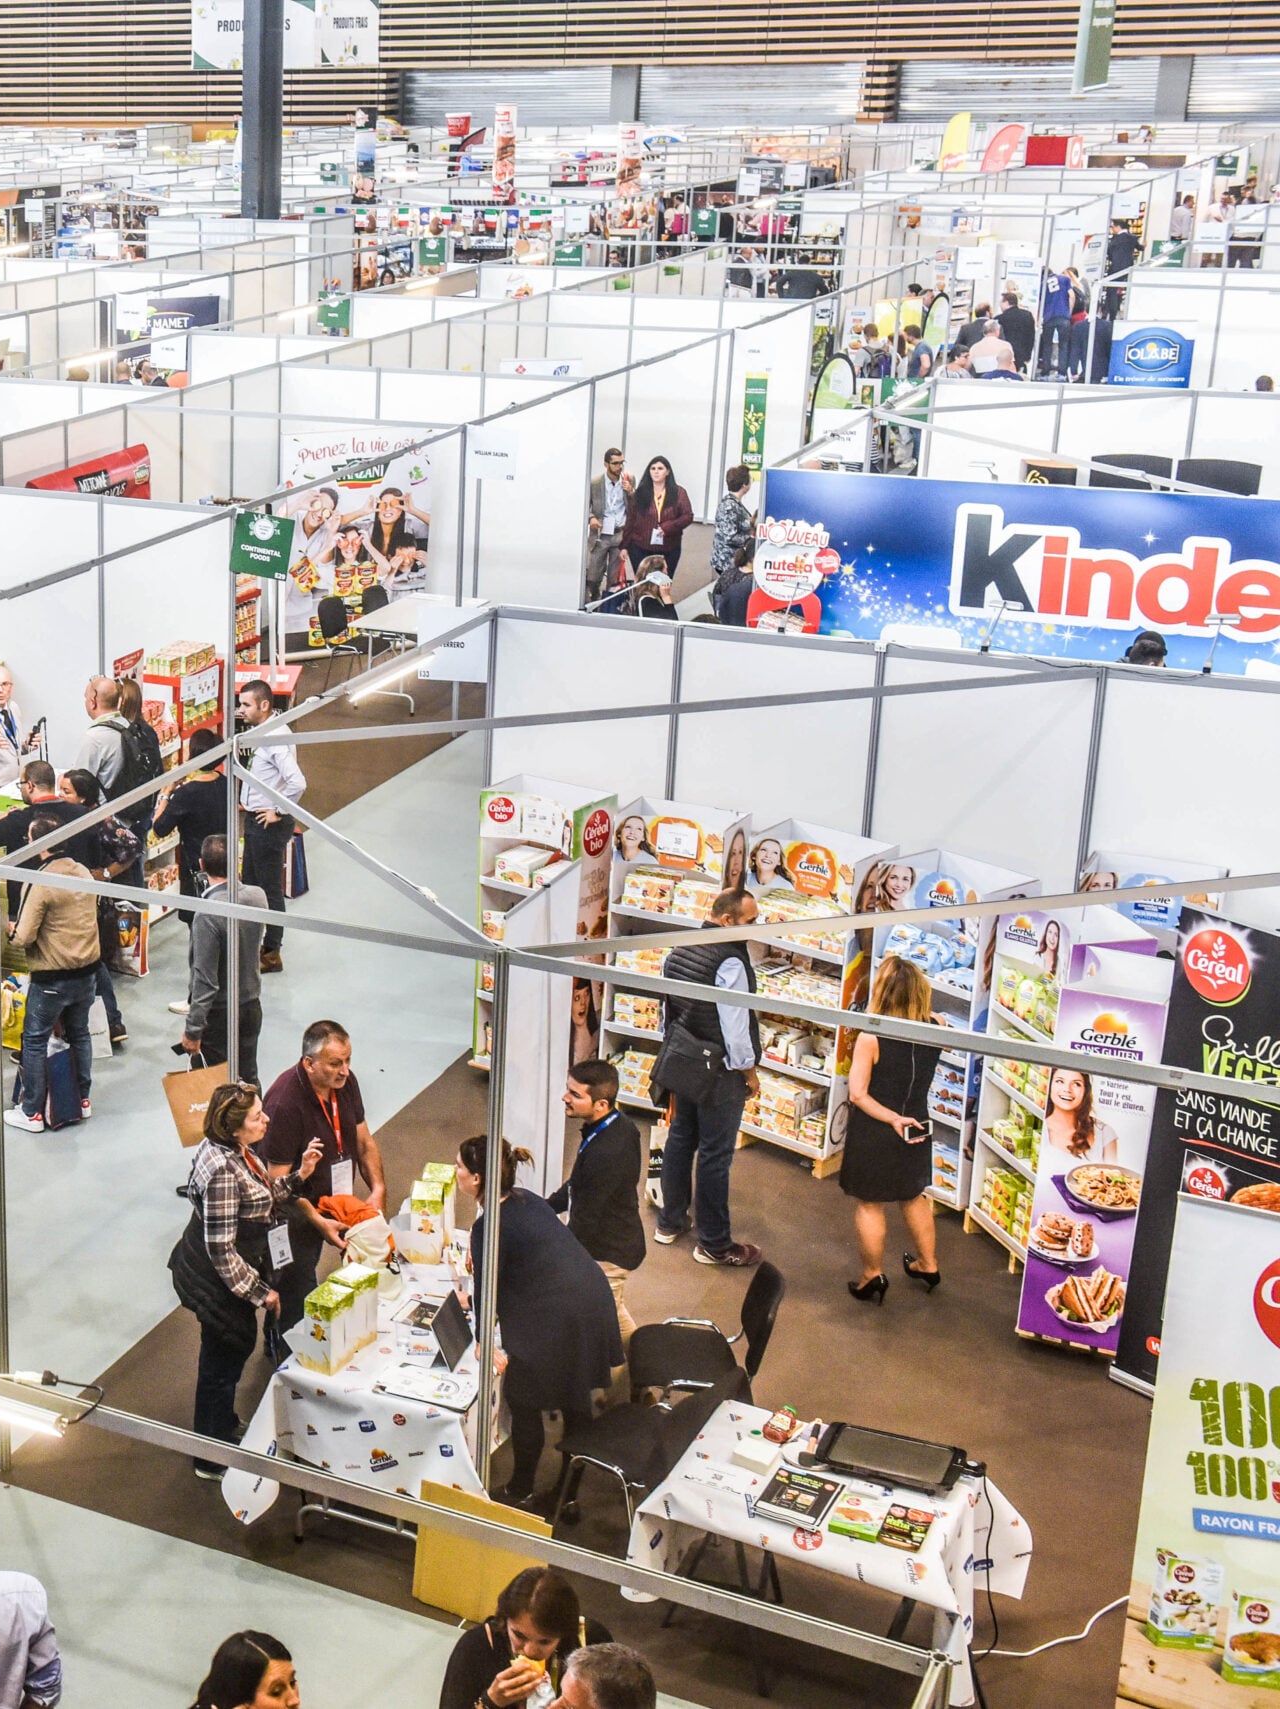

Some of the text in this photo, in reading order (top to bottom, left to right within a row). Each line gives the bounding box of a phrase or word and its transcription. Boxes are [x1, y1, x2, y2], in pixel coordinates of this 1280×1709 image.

[217, 20, 244, 32] PROD
[333, 17, 368, 28] PRODUITS FRAIS
[153, 317, 189, 328] MAMET
[298, 436, 388, 463] Prenez la vie
[759, 523, 828, 547] NOUVEAU
[241, 543, 281, 558] CONTINENTAL
[250, 553, 271, 562] FOODS
[764, 553, 813, 574] nutella
[959, 513, 1280, 629] Kinde
[489, 804, 513, 813] Céréal
[495, 812, 508, 820] bio
[584, 820, 608, 840] Céréal
[590, 838, 603, 851] bio
[799, 861, 829, 876] Gerblé
[929, 889, 957, 905] Gerblé
[1008, 924, 1036, 938] Gerblé
[1187, 949, 1244, 985] Céréal
[1080, 1028, 1137, 1048] Gerblé
[1073, 1043, 1140, 1061] SANS GLUTEN
[1100, 1089, 1114, 1097] Tout
[1098, 1097, 1111, 1106] sauf
[1114, 1099, 1121, 1107] le
[1177, 1088, 1271, 1132] SANS VIANDE
[1174, 1110, 1278, 1158] ET ÇA CHANGE
[1190, 1176, 1222, 1199] Céréal
[370, 1454, 393, 1465] Gerblé
[1201, 1514, 1254, 1532] RAYON
